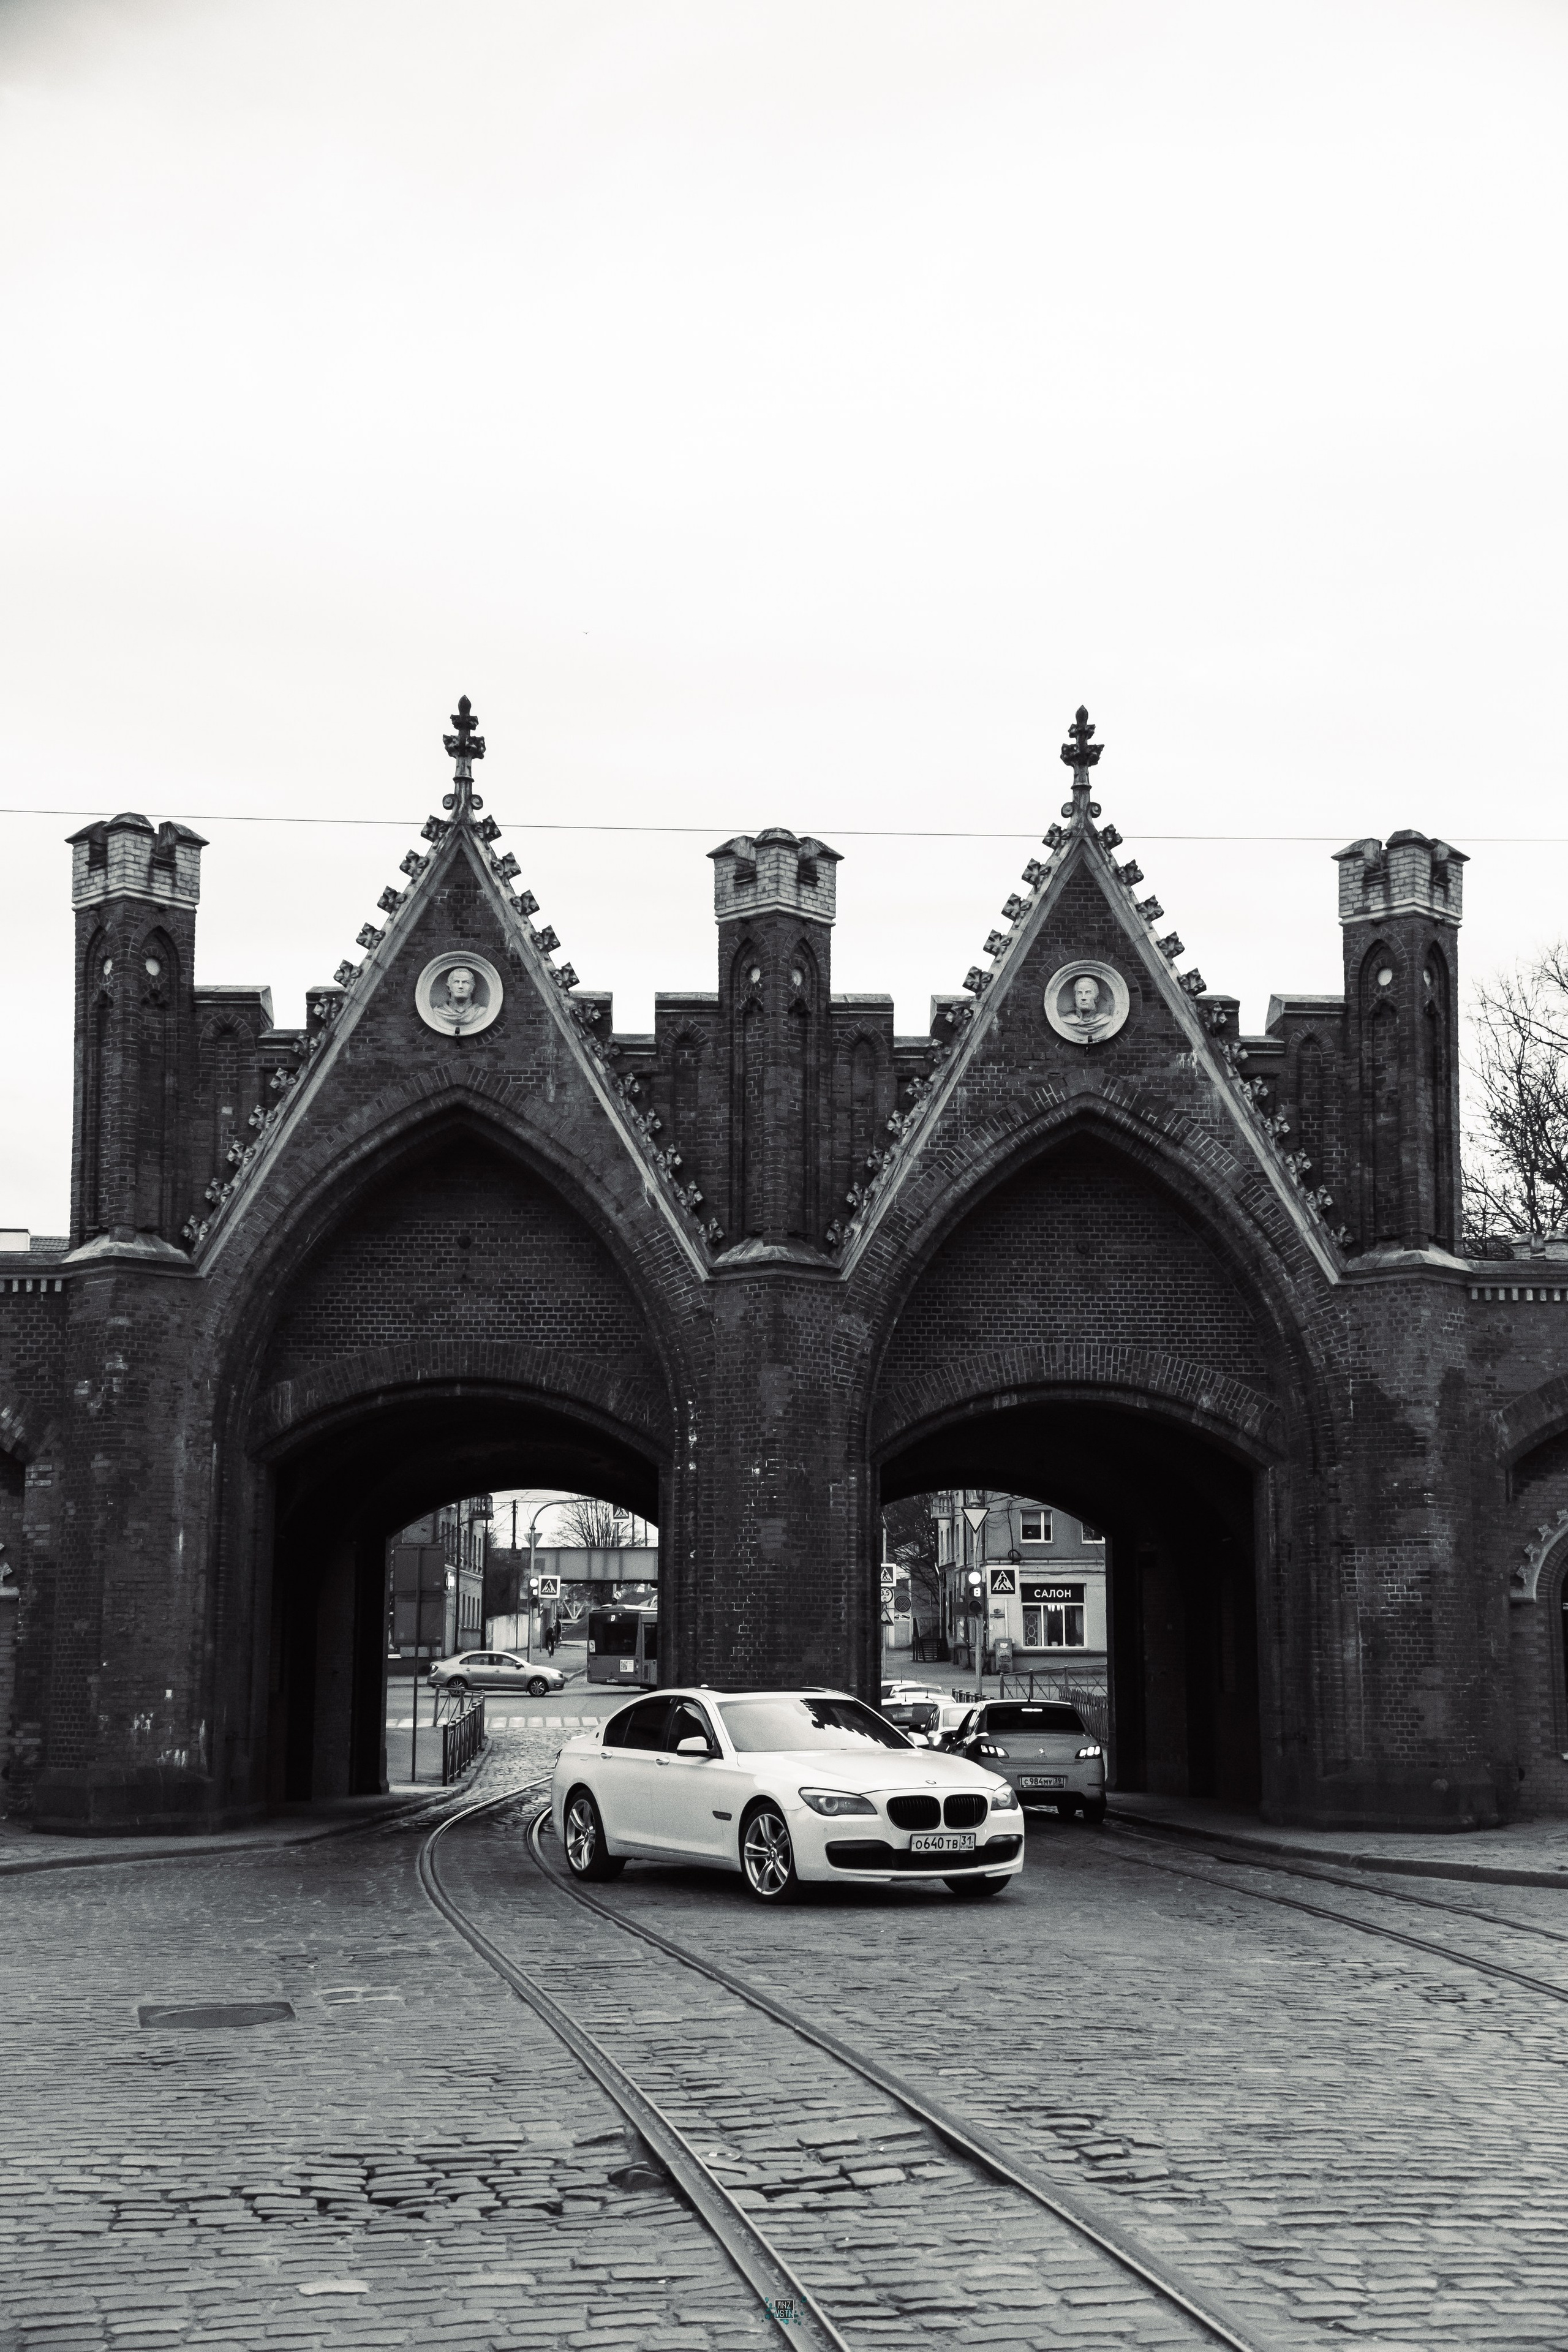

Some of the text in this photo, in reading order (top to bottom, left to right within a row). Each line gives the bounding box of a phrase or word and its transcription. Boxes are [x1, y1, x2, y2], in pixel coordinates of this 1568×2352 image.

[1034, 1589, 1071, 1598] САЛОН
[916, 1836, 971, 1849] О640ТВ 31
